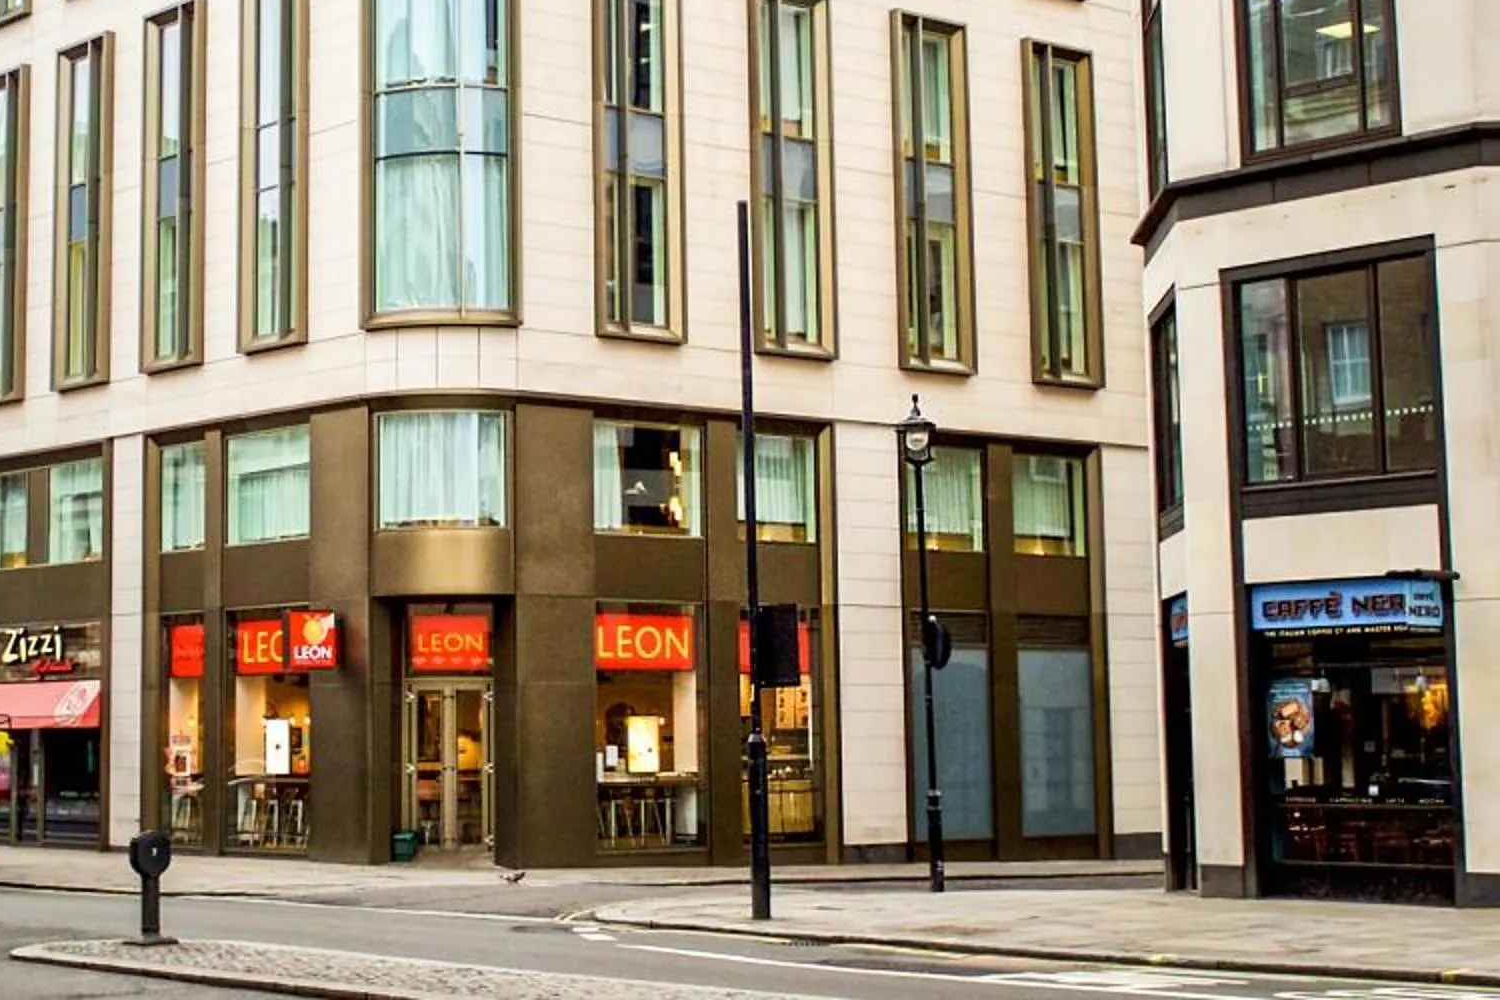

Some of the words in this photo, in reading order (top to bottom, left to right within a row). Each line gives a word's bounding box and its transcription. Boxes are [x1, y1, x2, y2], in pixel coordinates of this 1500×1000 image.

[1351, 593, 1406, 618] NER
[2, 625, 62, 663] Zizzi
[242, 629, 283, 664] LEO
[293, 645, 333, 660] LEON
[417, 632, 484, 653] LEON
[596, 625, 690, 659] LEON
